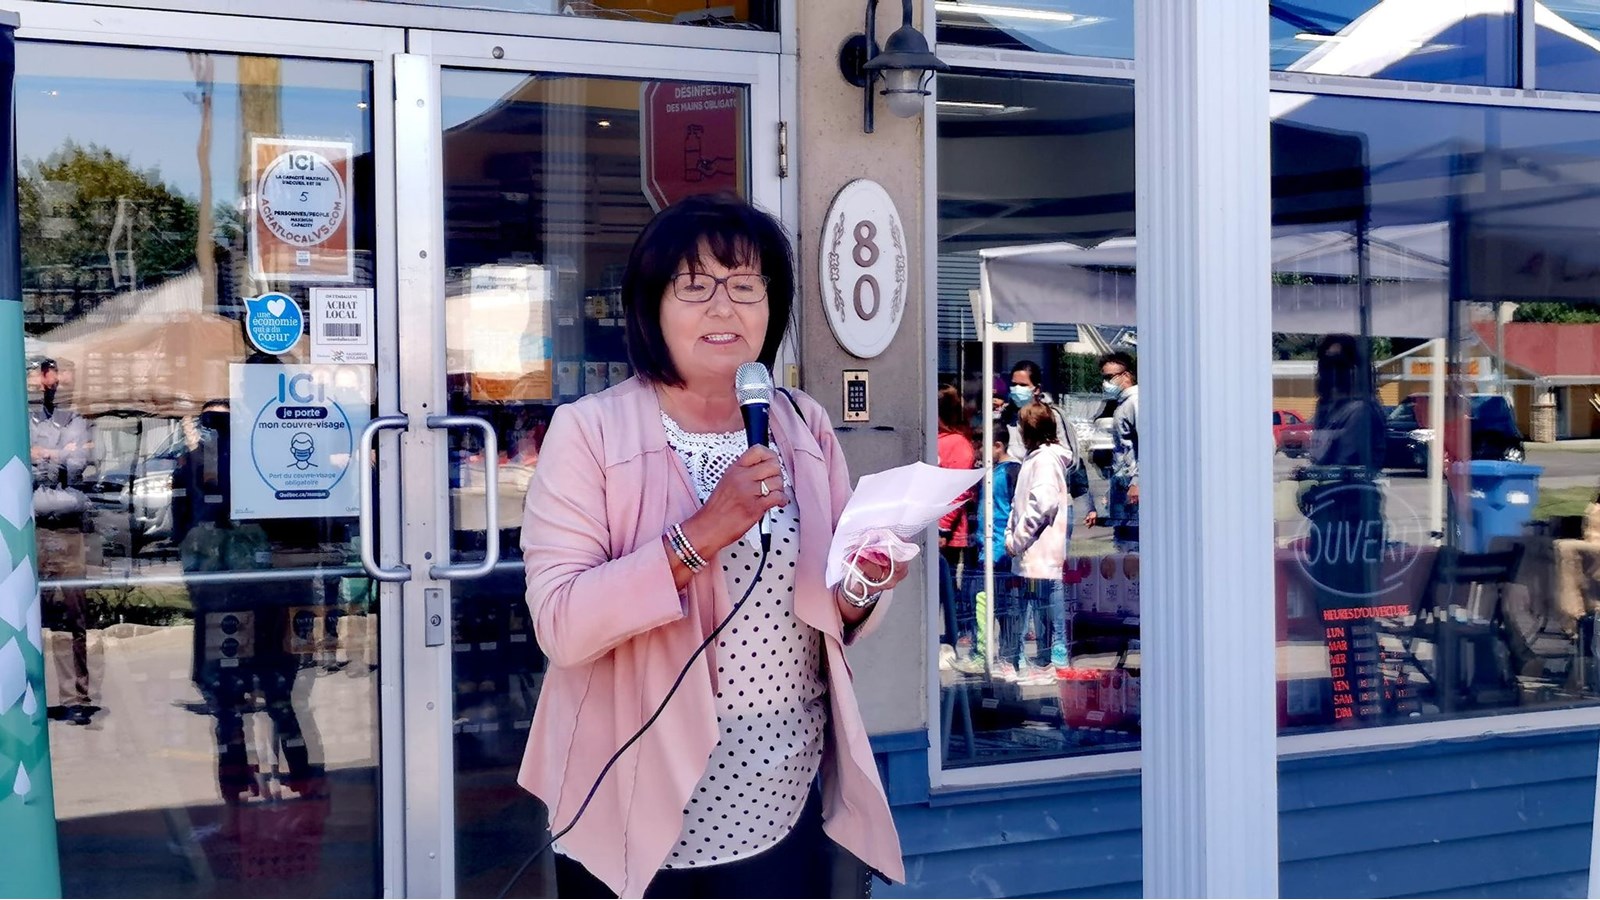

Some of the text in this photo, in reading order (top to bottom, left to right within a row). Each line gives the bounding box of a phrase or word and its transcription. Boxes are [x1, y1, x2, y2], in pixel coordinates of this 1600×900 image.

[666, 103, 680, 113] DES
[680, 101, 702, 111] MAINS
[288, 154, 314, 171] ICI
[299, 191, 309, 202] 5
[273, 210, 330, 218] PERSONNES/PEOPLE
[261, 198, 342, 243] ACHATLOCALVS.COM
[325, 300, 358, 310] ACHAT
[325, 310, 358, 319] LOCAL
[252, 316, 298, 328] économie
[252, 325, 264, 334] qui
[257, 332, 290, 342] cœur
[278, 373, 326, 404] ICI
[282, 408, 321, 419] je porte
[258, 420, 345, 430] mon couvre-visage
[1302, 519, 1408, 567] OUVERT
[1326, 627, 1345, 638] LUN
[1334, 694, 1353, 705] SAM
[1335, 707, 1352, 718] DIM
